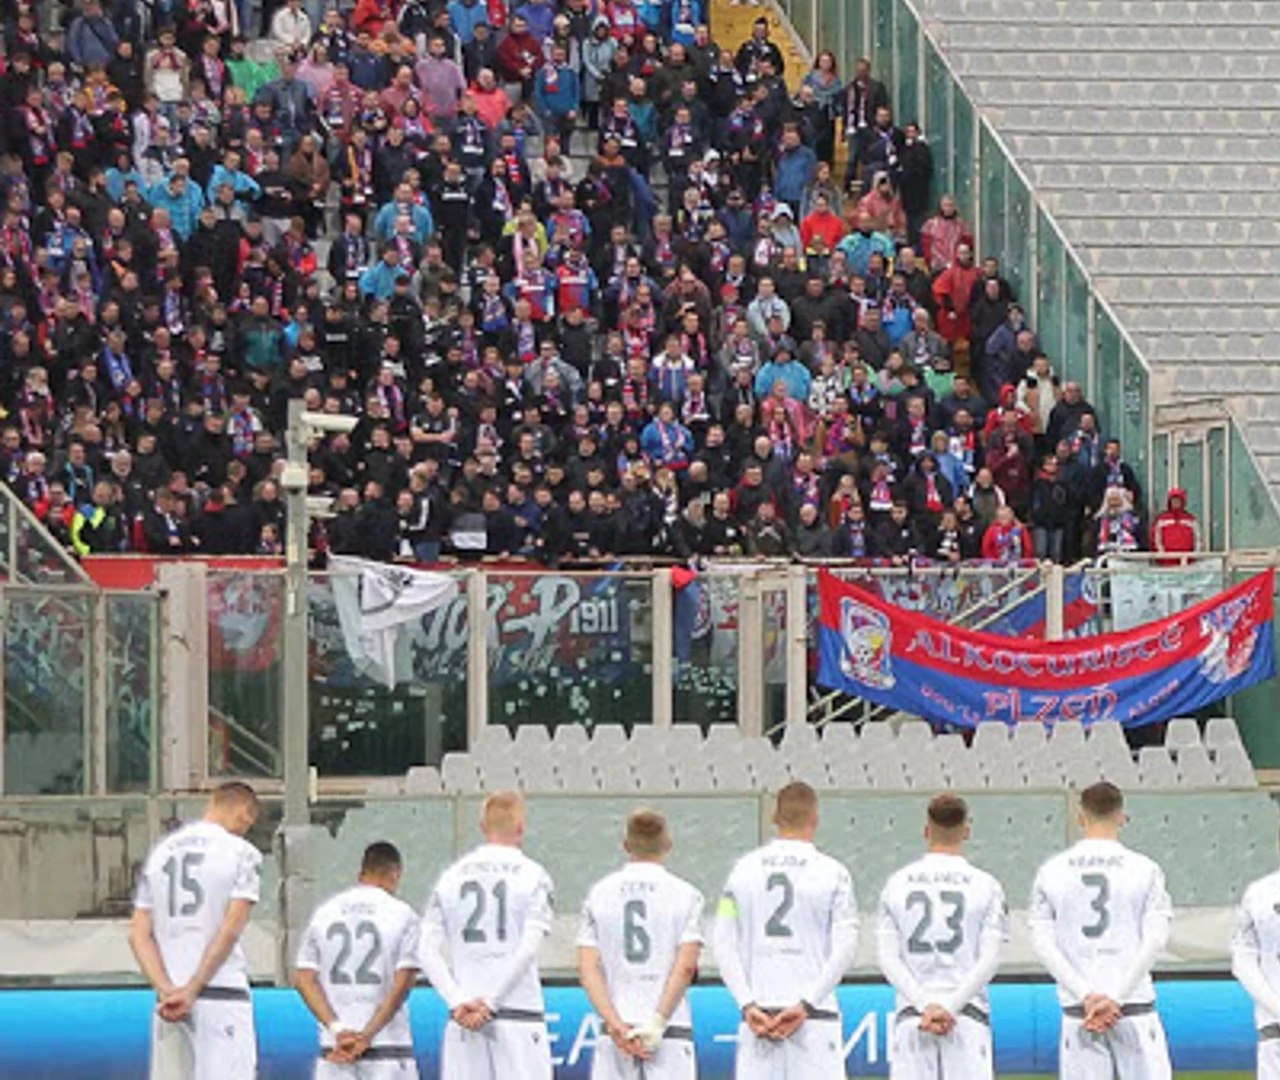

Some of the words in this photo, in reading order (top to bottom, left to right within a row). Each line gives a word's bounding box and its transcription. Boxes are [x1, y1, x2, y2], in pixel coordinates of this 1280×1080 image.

[570, 594, 618, 635] 1911
[162, 852, 205, 918] 15
[460, 880, 506, 943] 21
[764, 872, 794, 937] 2
[1081, 874, 1110, 938] 3
[326, 920, 382, 985] 22
[623, 900, 650, 964] 6
[905, 891, 964, 953] 23
